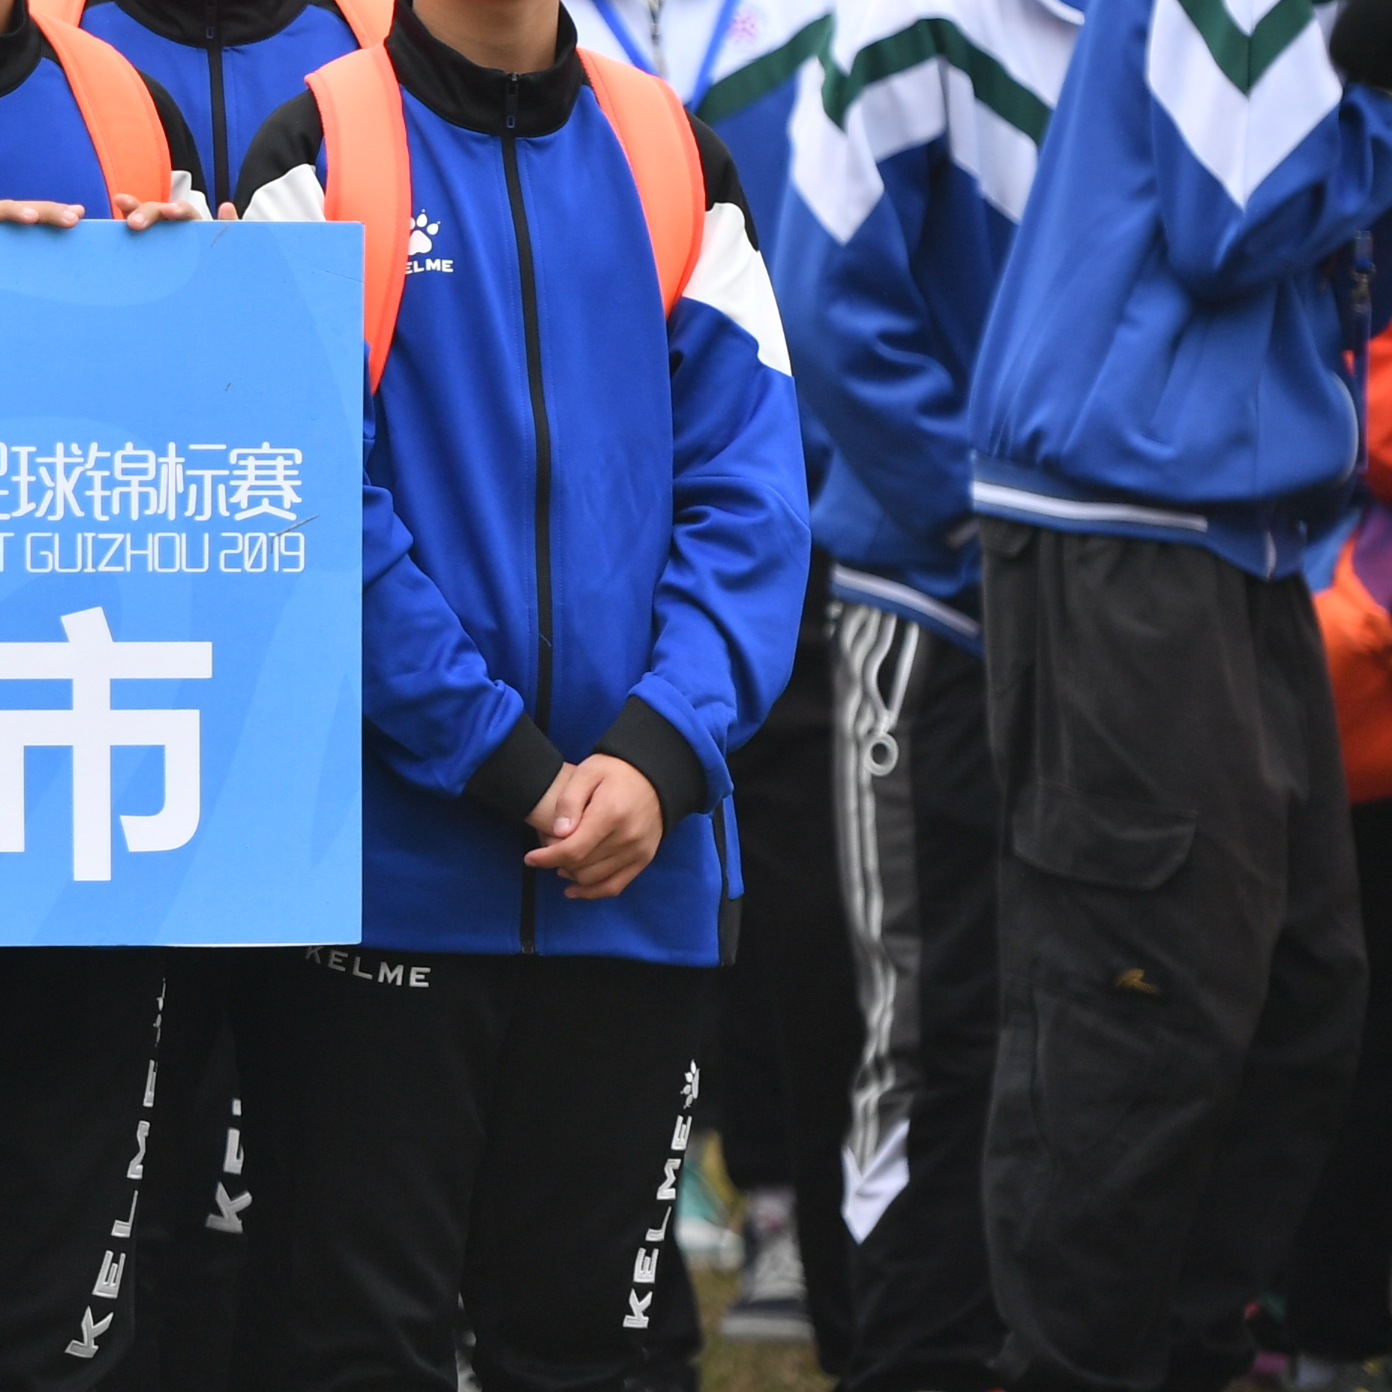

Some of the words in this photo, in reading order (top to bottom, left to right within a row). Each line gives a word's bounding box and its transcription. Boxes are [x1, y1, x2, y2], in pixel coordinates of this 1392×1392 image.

[405, 259, 454, 274] ELME
[25, 532, 210, 573] GUIZHOU
[219, 532, 306, 573] 2019
[305, 945, 431, 988] KELME
[64, 1059, 158, 1359] KELME
[623, 1115, 692, 1328] KELME
